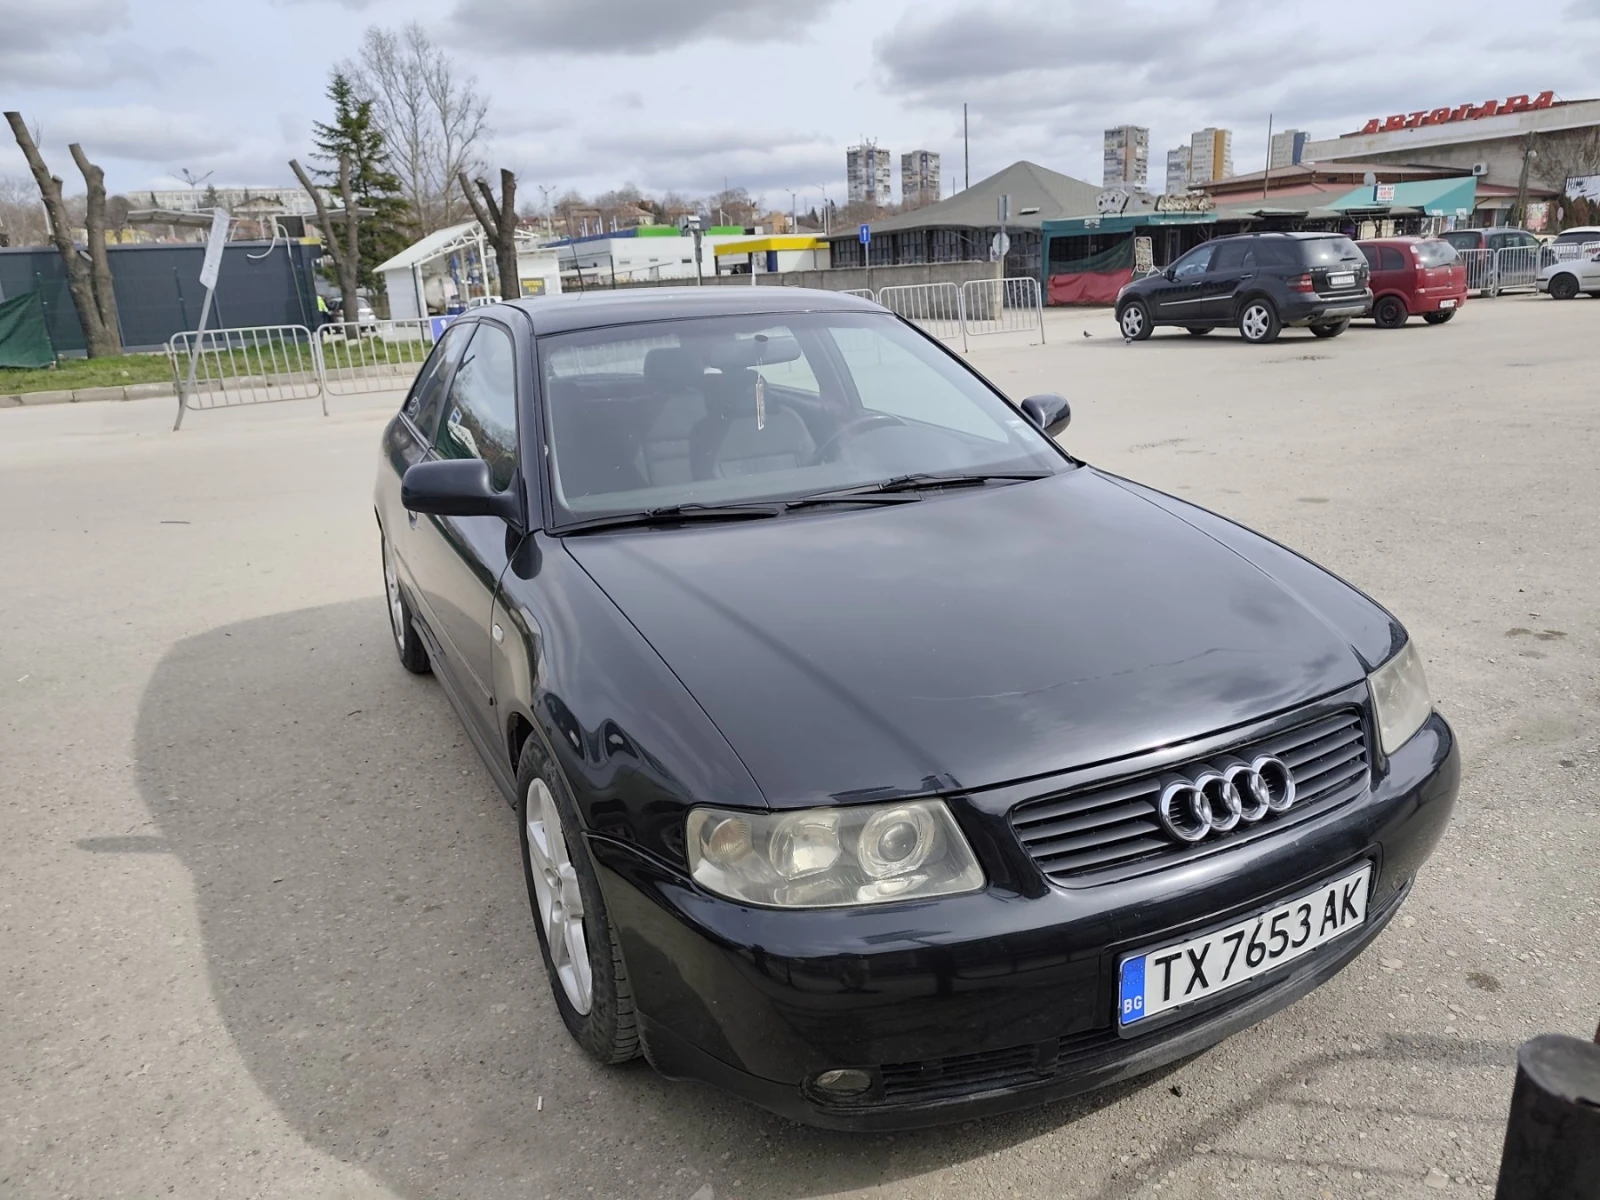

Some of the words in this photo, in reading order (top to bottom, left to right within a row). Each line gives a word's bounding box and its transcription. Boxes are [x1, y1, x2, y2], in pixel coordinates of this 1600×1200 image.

[1361, 90, 1555, 134] АВТОГАРА
[1154, 942, 1211, 1001] TX
[1221, 903, 1312, 983] 7653
[1319, 877, 1363, 937] AK
[1123, 995, 1143, 1014] BG
